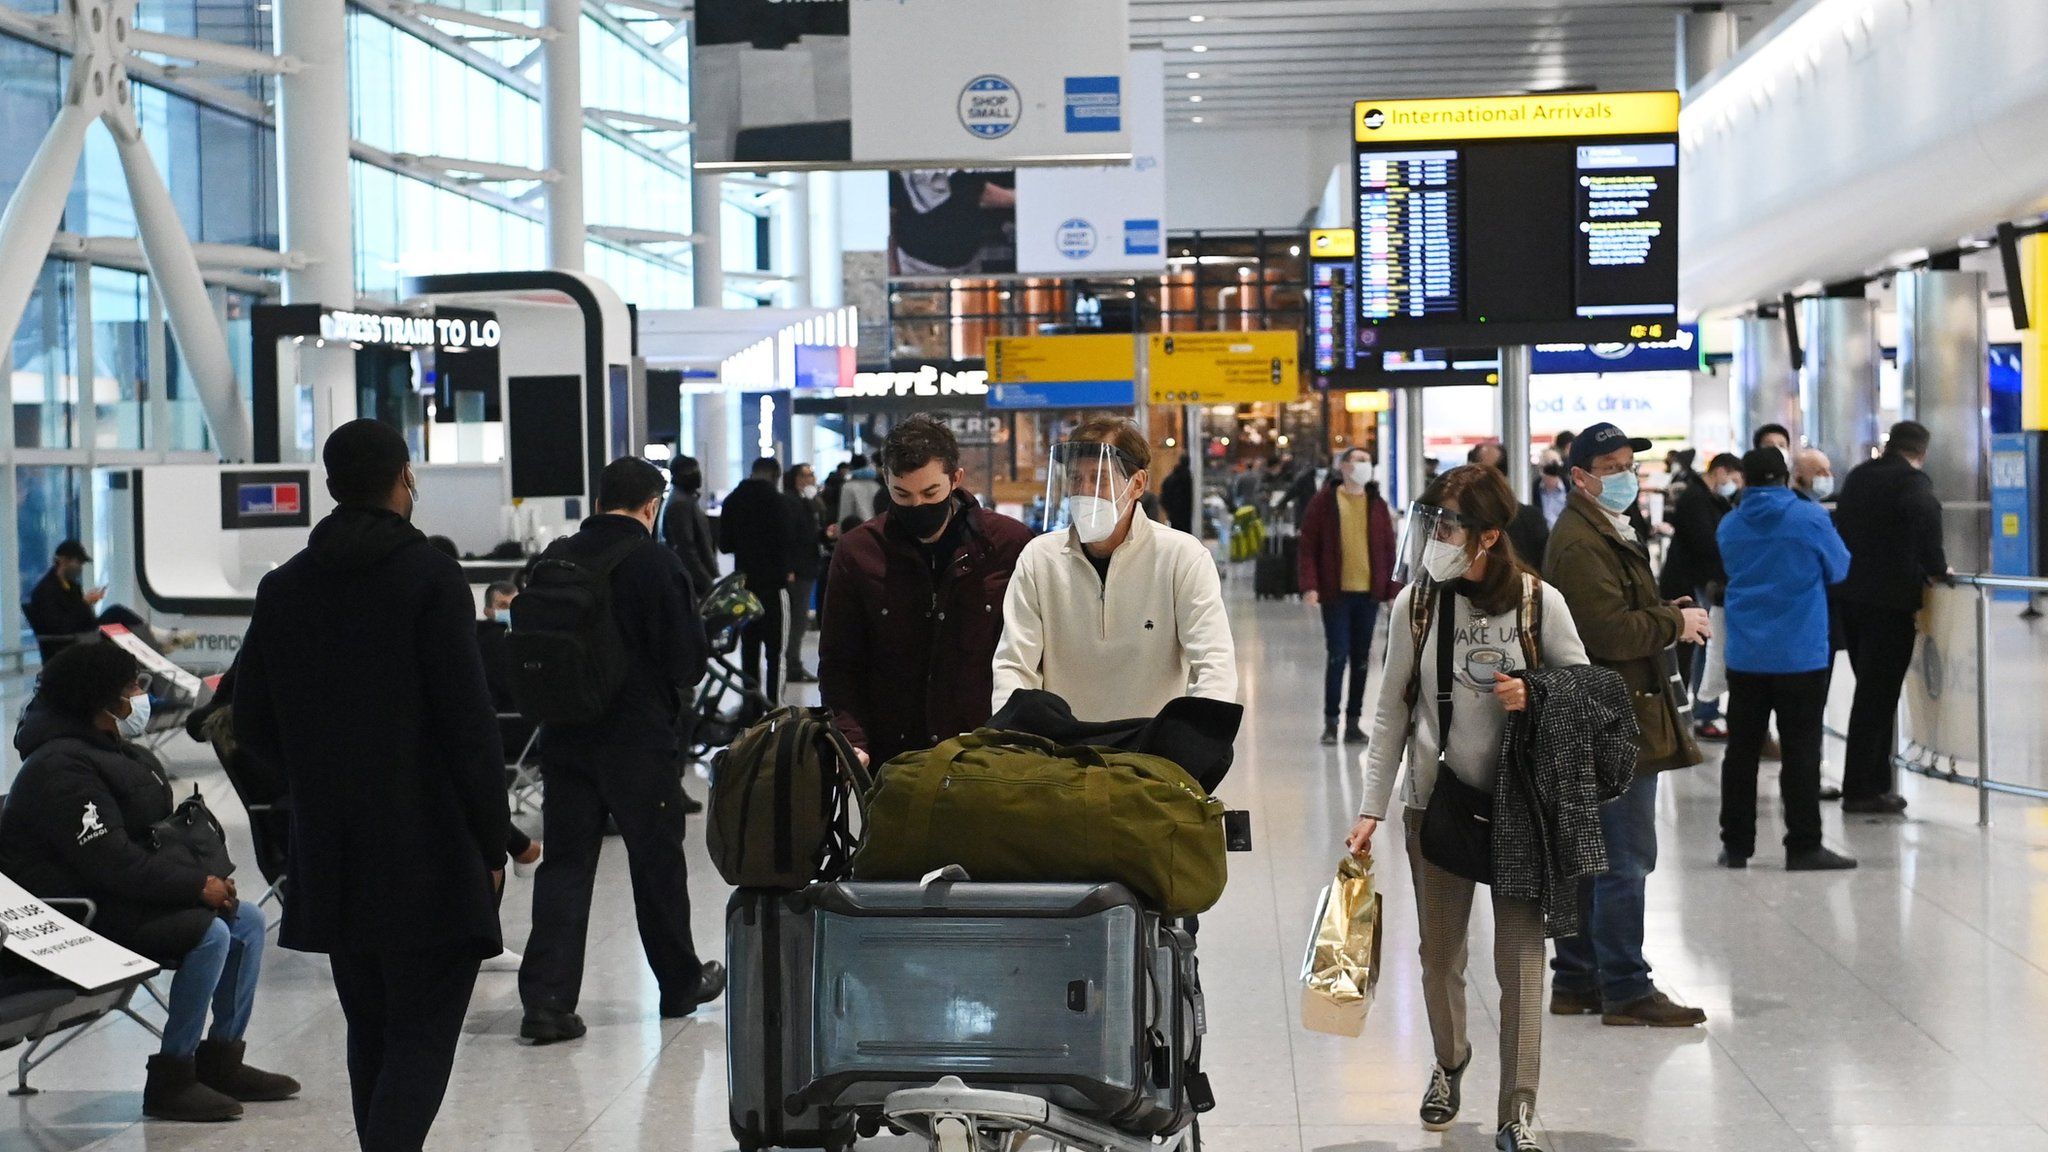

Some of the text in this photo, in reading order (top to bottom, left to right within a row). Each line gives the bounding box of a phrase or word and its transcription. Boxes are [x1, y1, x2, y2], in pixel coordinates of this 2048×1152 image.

[971, 95, 1009, 107] SHOP
[967, 108, 1011, 119] SMALL
[1391, 102, 1613, 124] International Arrivals
[381, 315, 435, 345] TRAIN
[436, 318, 467, 347] TO
[1597, 394, 1653, 412] drink
[18, 903, 45, 917] use
[33, 919, 65, 936] seat
